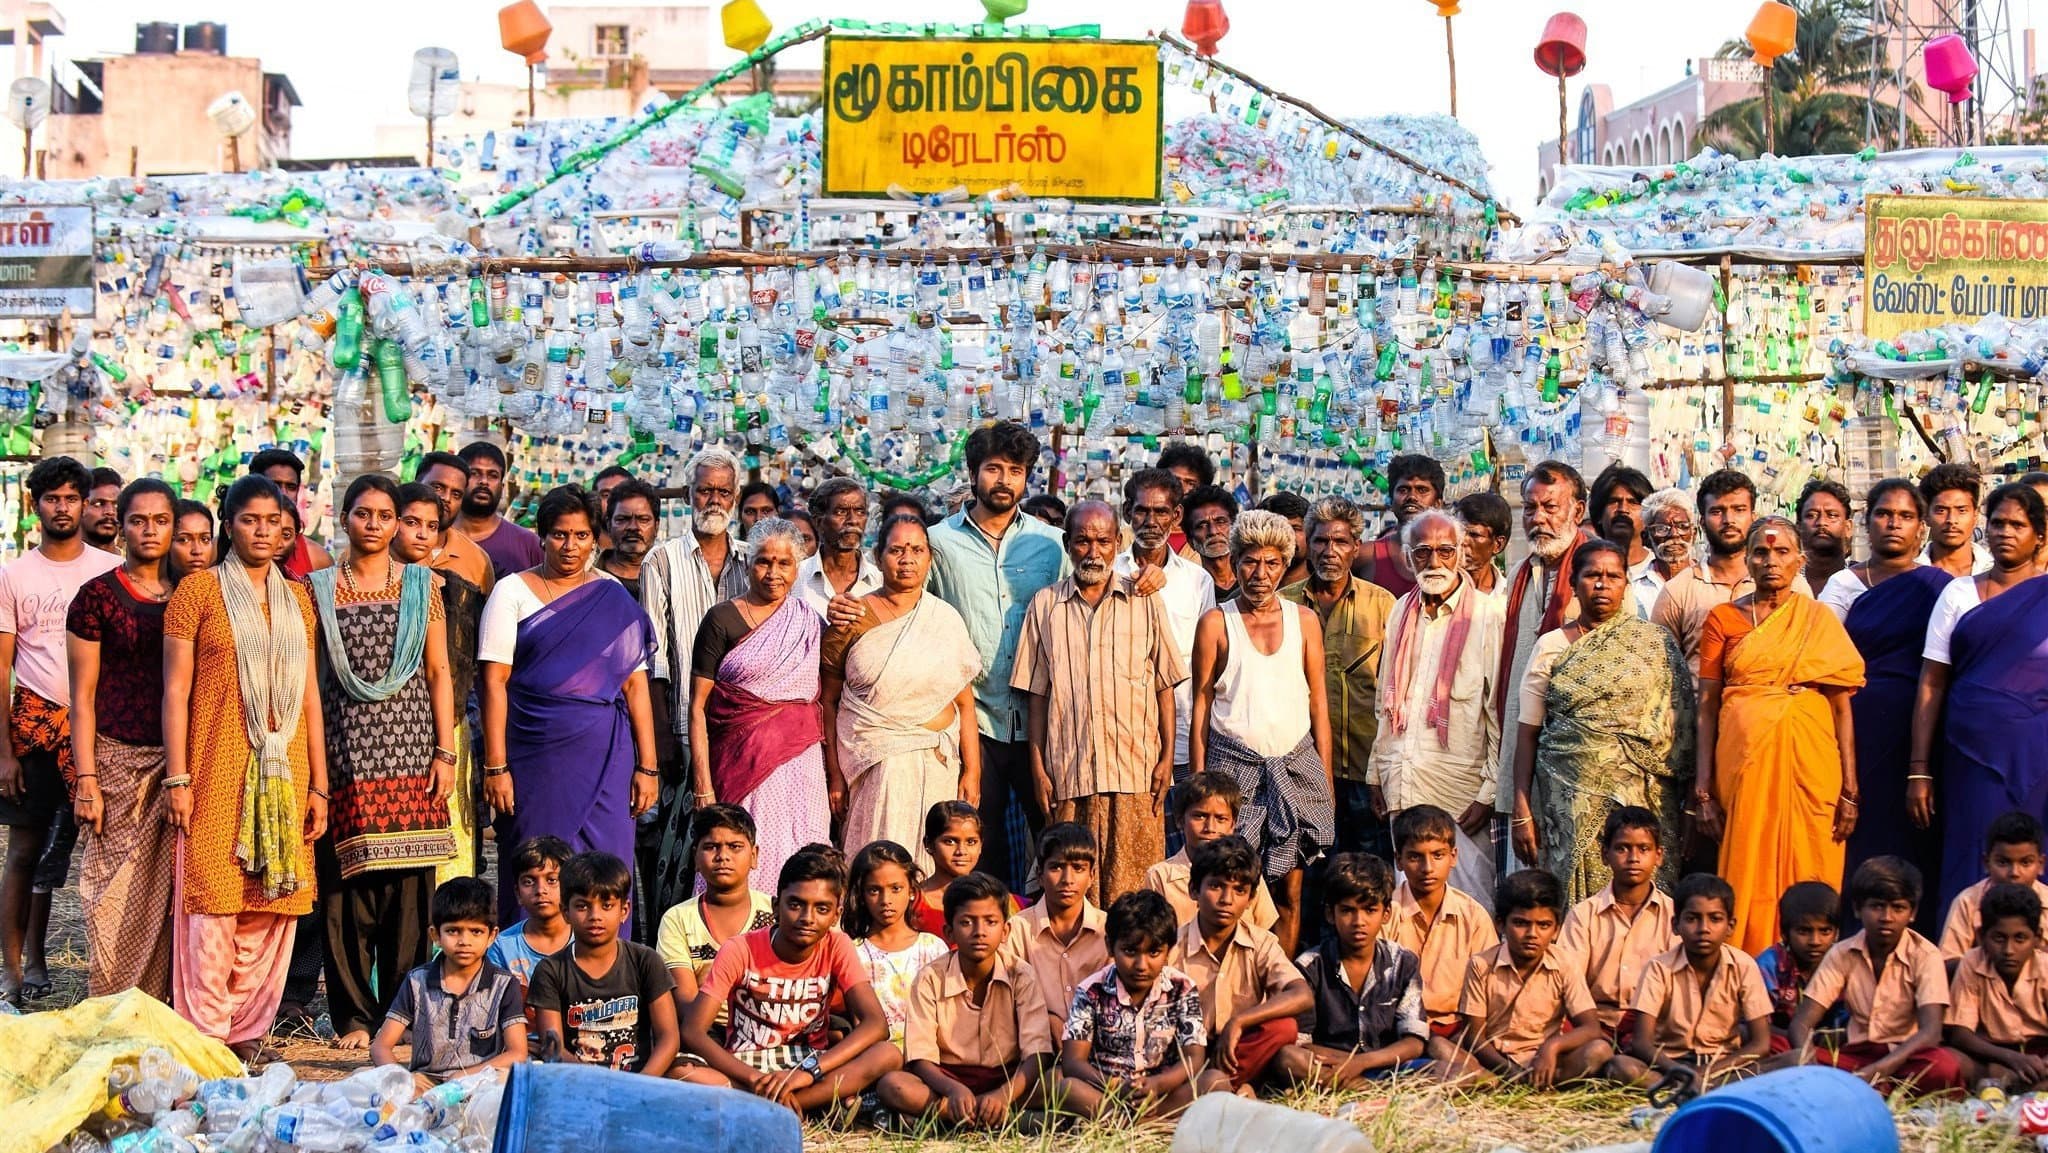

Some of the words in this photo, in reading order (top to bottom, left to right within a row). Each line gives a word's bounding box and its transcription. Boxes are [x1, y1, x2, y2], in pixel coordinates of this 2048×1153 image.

[833, 51, 1142, 122] மூகாம்பிகை
[902, 124, 1066, 168] டிரேடர்ஸ்
[1873, 273, 1946, 315] வேஸ்ட்
[1951, 275, 2017, 317] பேப்பர்
[767, 975, 831, 1000] THEY
